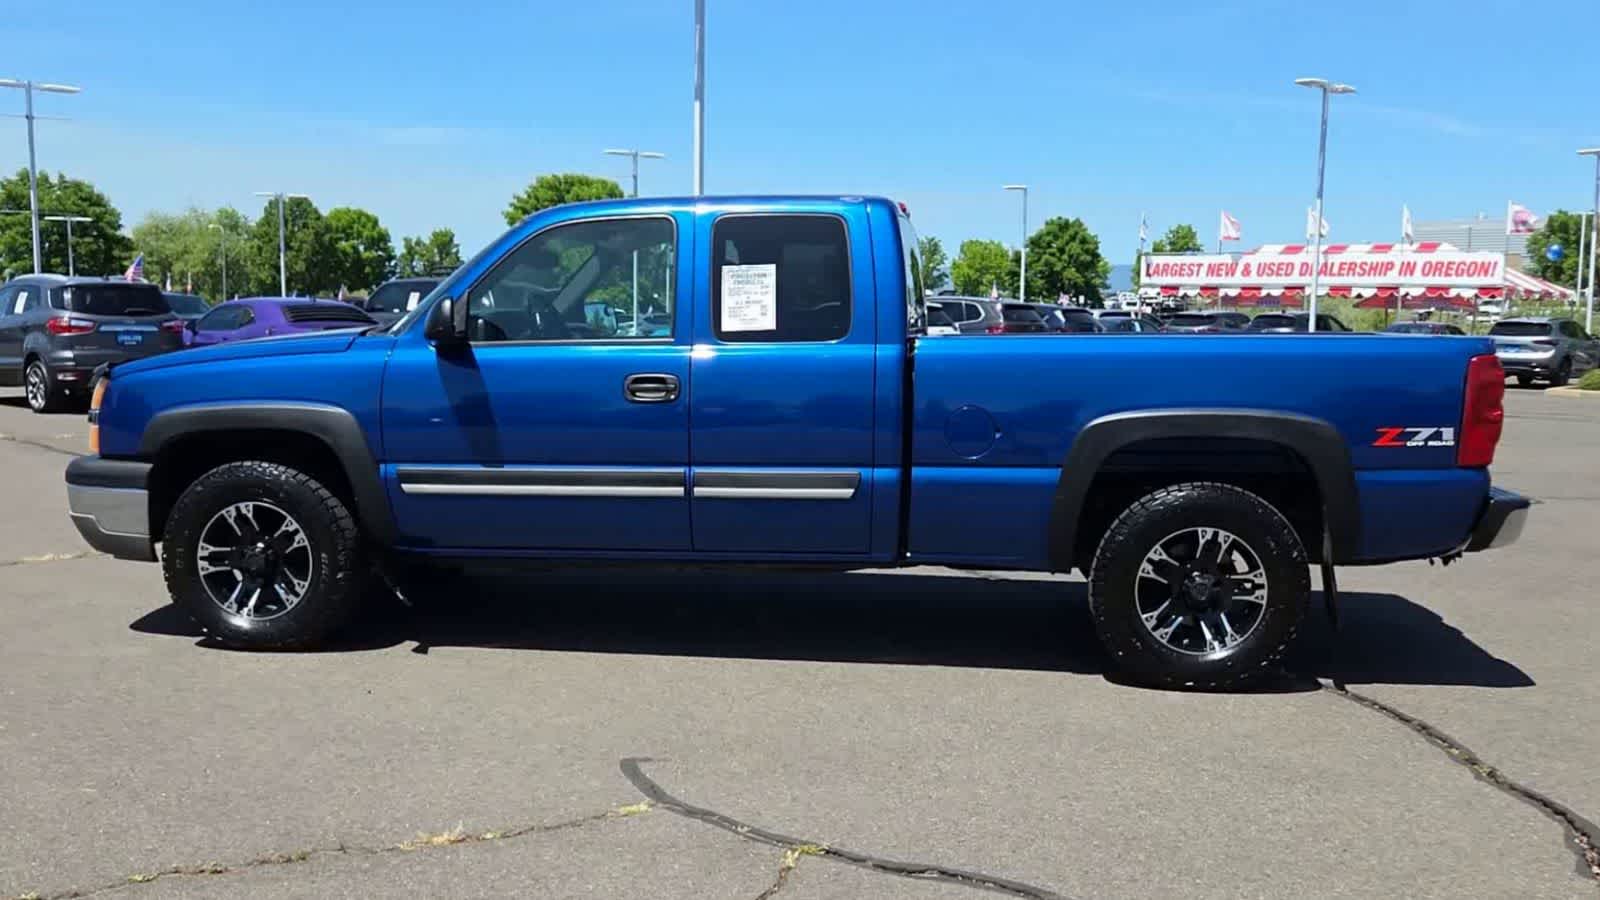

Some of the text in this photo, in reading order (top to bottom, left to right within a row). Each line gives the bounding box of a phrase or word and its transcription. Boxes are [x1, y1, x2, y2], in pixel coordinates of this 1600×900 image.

[1145, 263, 1202, 278] LARGEST
[1206, 262, 1239, 277] NEW
[1241, 263, 1252, 277] &
[1256, 262, 1295, 277] USED
[1398, 261, 1417, 277] IN
[1421, 261, 1498, 277] OREGON!
[1372, 427, 1455, 446] Z71
